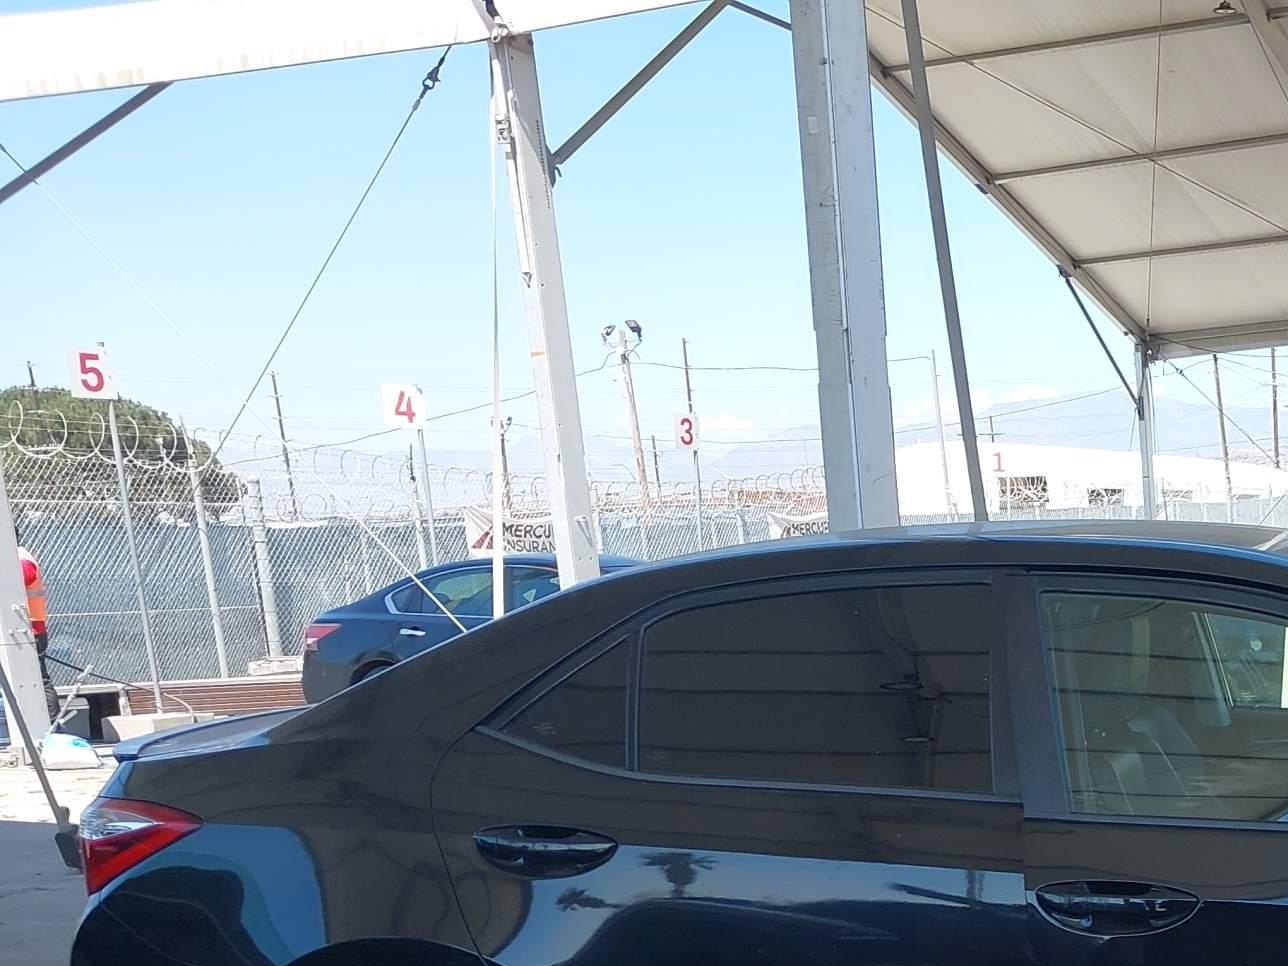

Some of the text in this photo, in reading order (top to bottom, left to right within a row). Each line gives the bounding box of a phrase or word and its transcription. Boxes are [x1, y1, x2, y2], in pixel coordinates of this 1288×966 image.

[79, 352, 105, 392] 5
[395, 390, 416, 423] 4
[680, 417, 693, 445] 3
